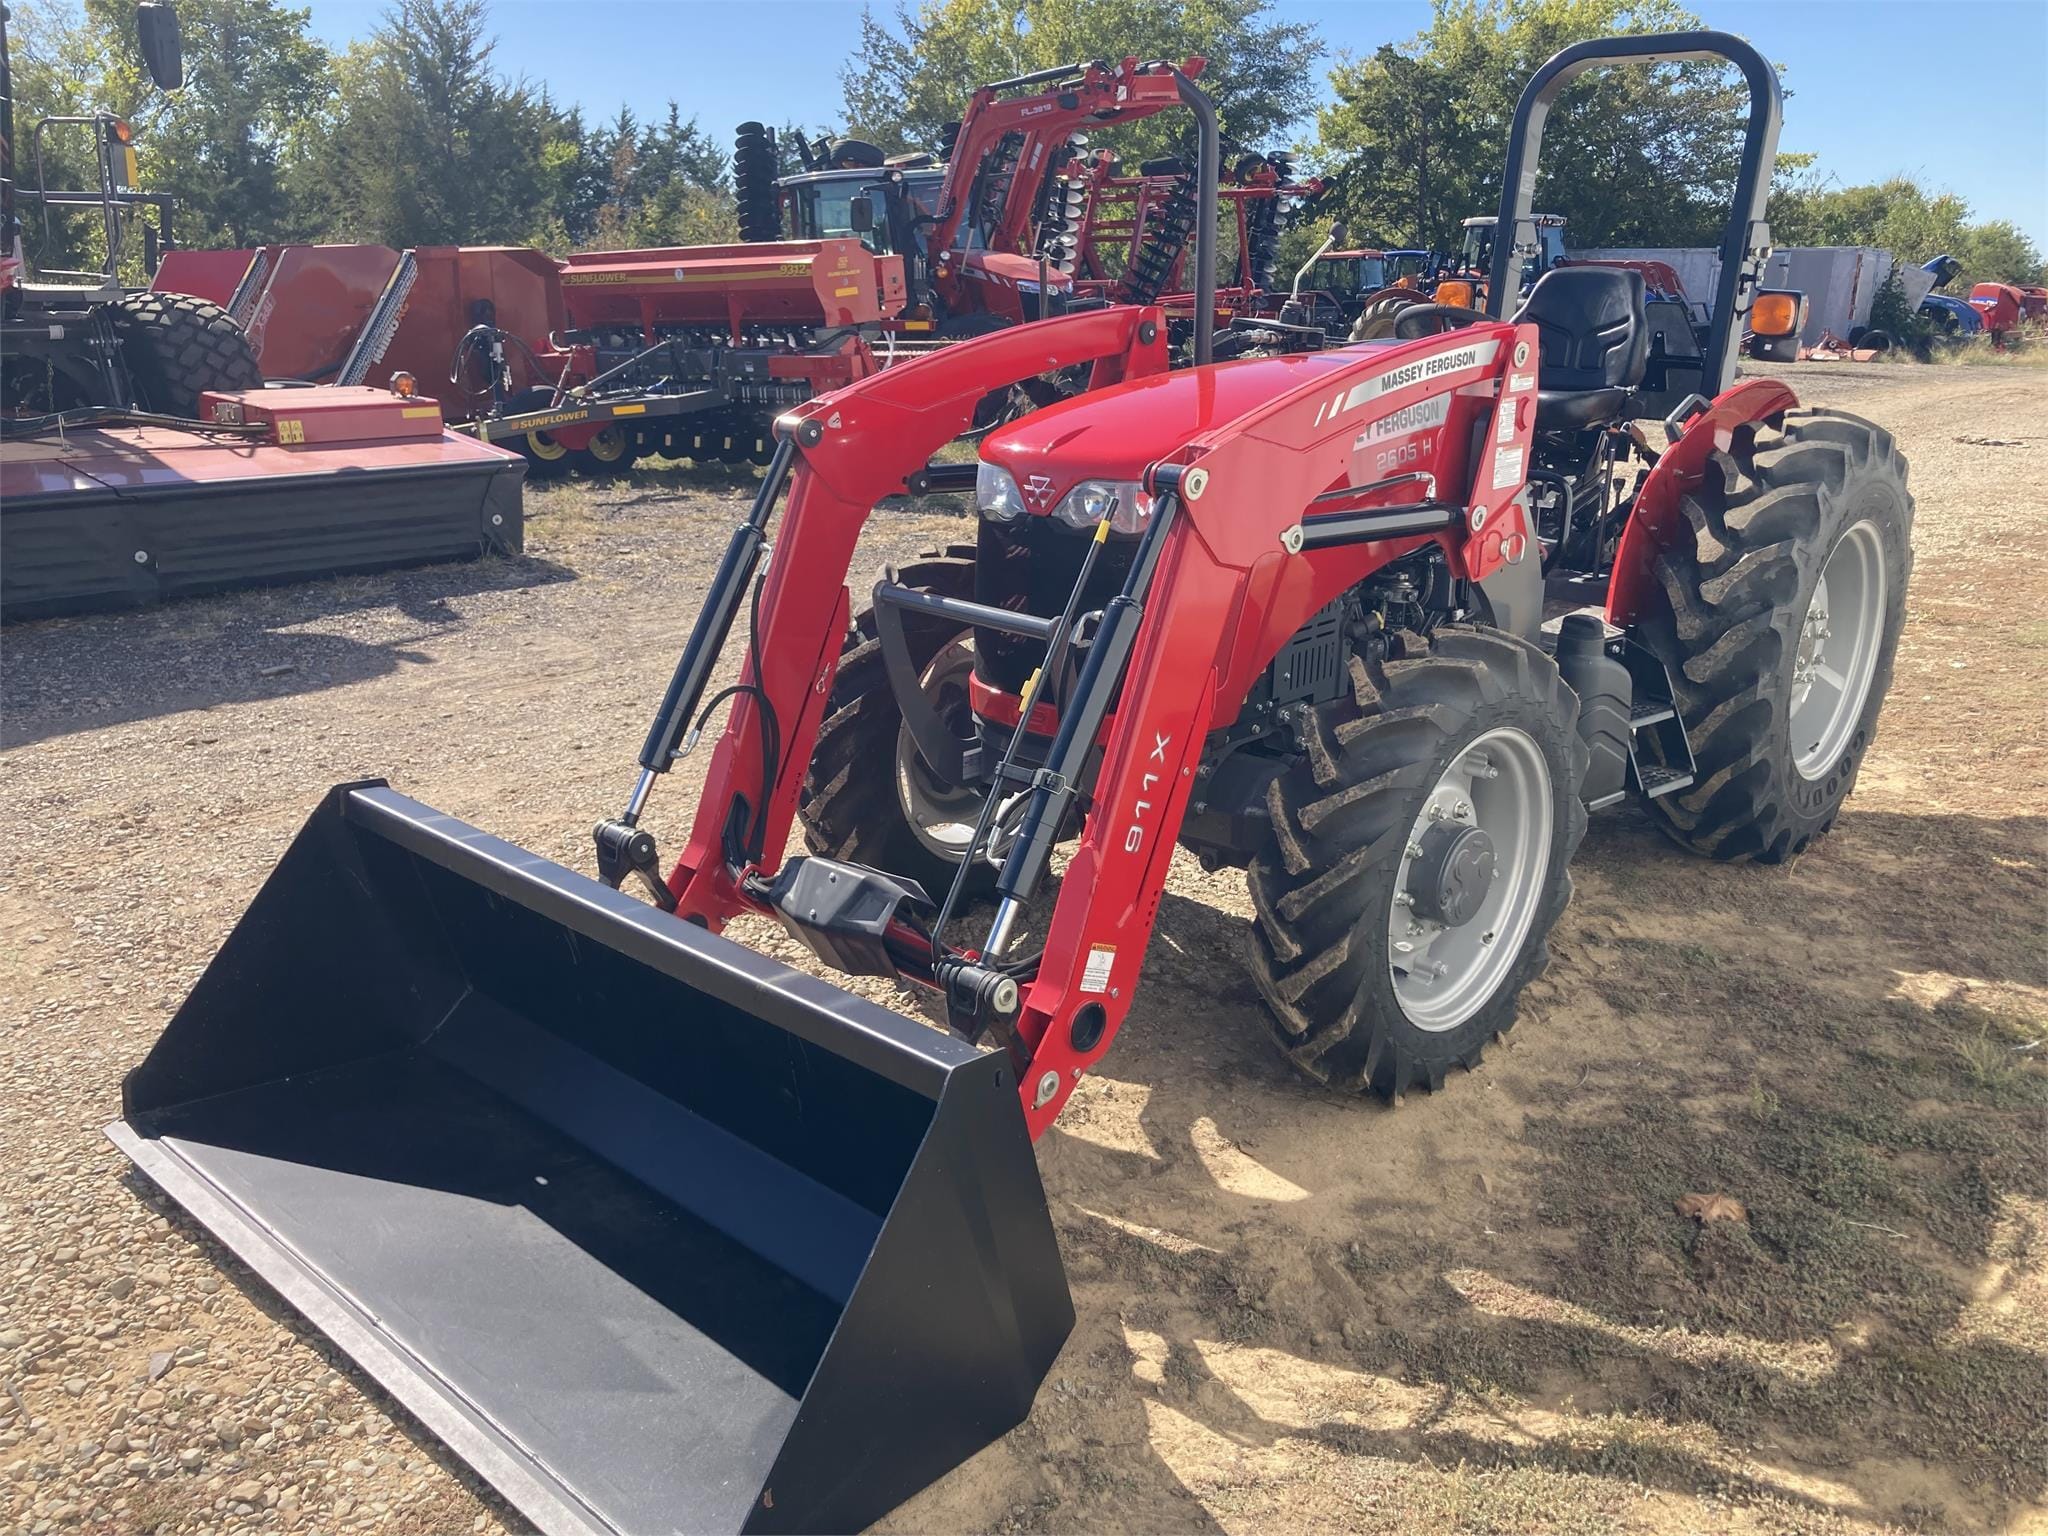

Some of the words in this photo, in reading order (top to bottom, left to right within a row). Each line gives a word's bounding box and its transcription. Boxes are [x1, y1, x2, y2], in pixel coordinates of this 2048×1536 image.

[570, 272, 627, 284] SUNFLOWER
[780, 264, 807, 276] 9312
[1381, 363, 1424, 392] MASSEY
[1425, 350, 1476, 376] FERGUSON
[520, 410, 589, 430] SUNFLOWER
[1376, 401, 1440, 437] FERGUSON
[1376, 442, 1418, 472] 2605
[1423, 437, 1432, 457] H
